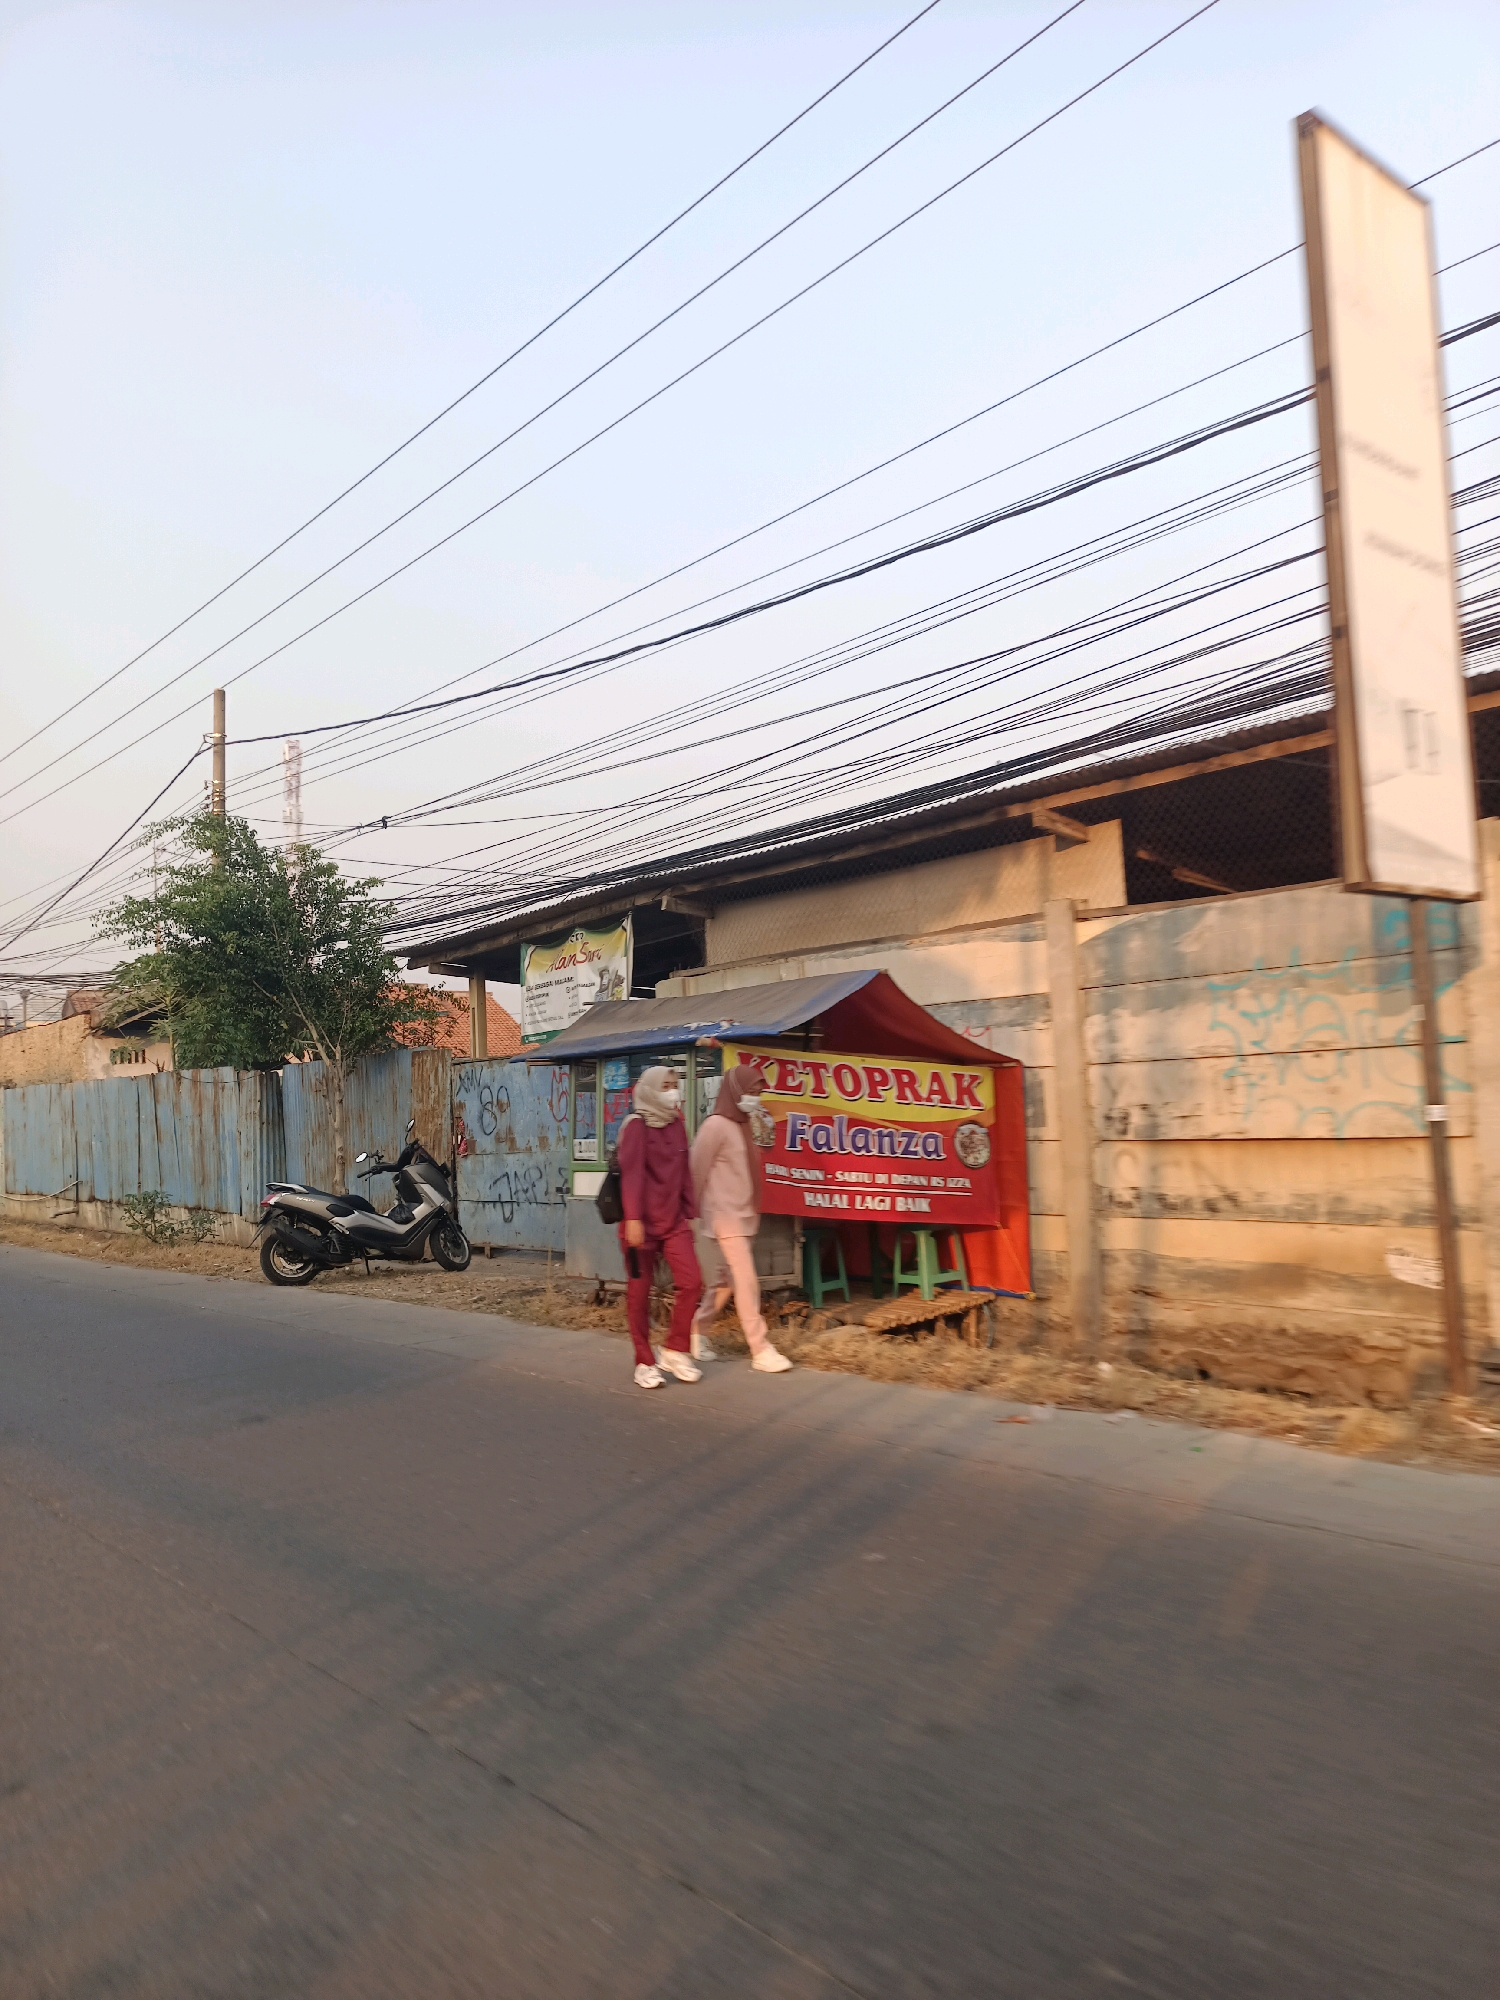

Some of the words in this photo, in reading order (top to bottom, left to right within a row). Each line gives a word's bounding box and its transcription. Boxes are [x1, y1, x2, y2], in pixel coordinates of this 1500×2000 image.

[736, 1050, 985, 1111] KETOPRAK
[785, 1111, 948, 1160] Falanza
[790, 1167, 825, 1181] SENIN
[834, 1170, 874, 1184] SABTU
[890, 1173, 929, 1187] DEPAN
[803, 1191, 851, 1210] HALAL
[854, 1194, 892, 1212] LAGI
[894, 1196, 932, 1213] BAIK
